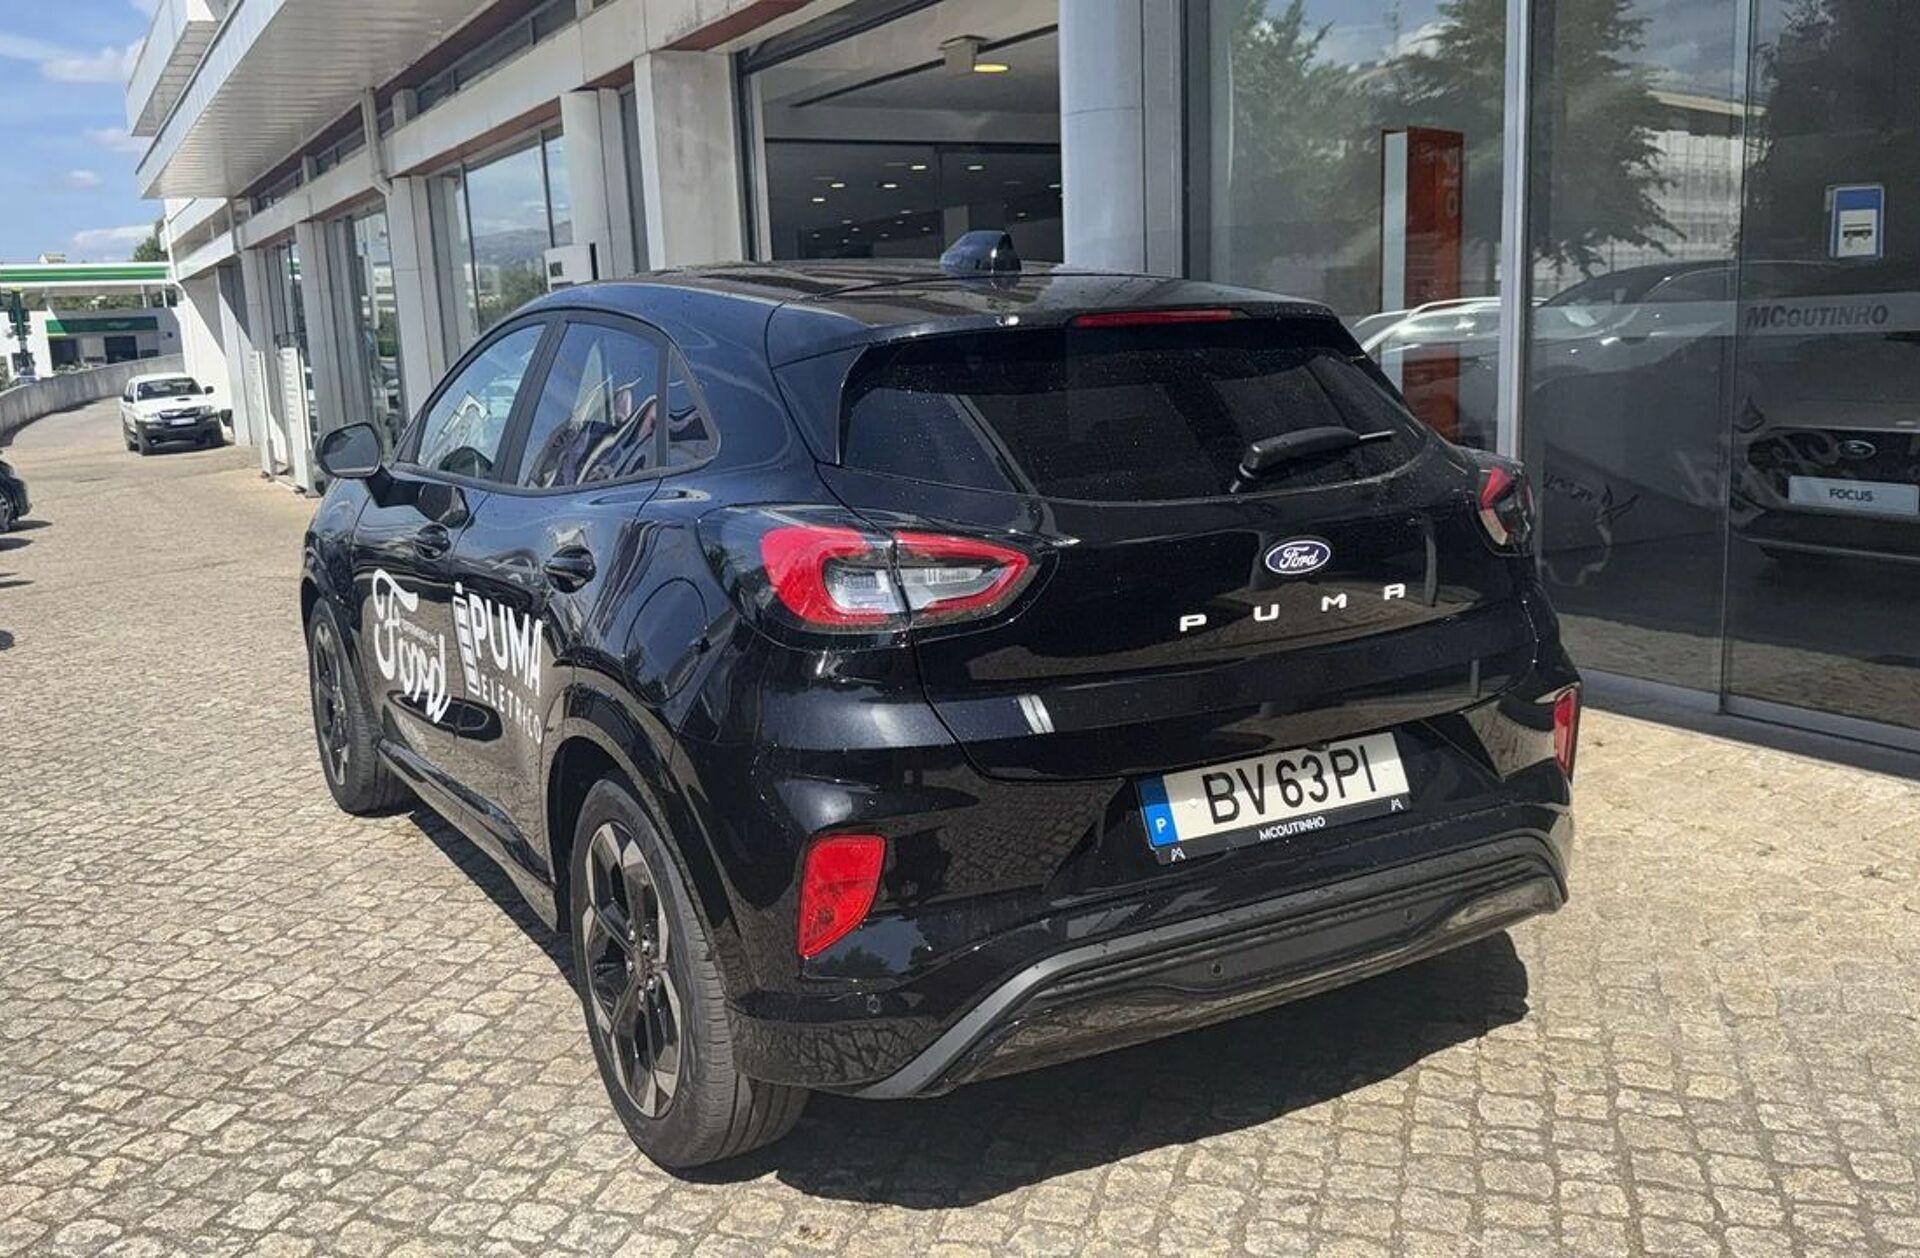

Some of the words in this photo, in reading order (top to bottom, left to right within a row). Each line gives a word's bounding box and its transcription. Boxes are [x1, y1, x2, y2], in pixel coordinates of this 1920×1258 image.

[1829, 487, 1873, 502] FOCUS
[1279, 546, 1319, 570] Ford
[1179, 582, 1406, 633] PUMA
[372, 568, 451, 723] Ford
[1155, 816, 1167, 834] P
[1258, 815, 1326, 841] MCOUTINHO
